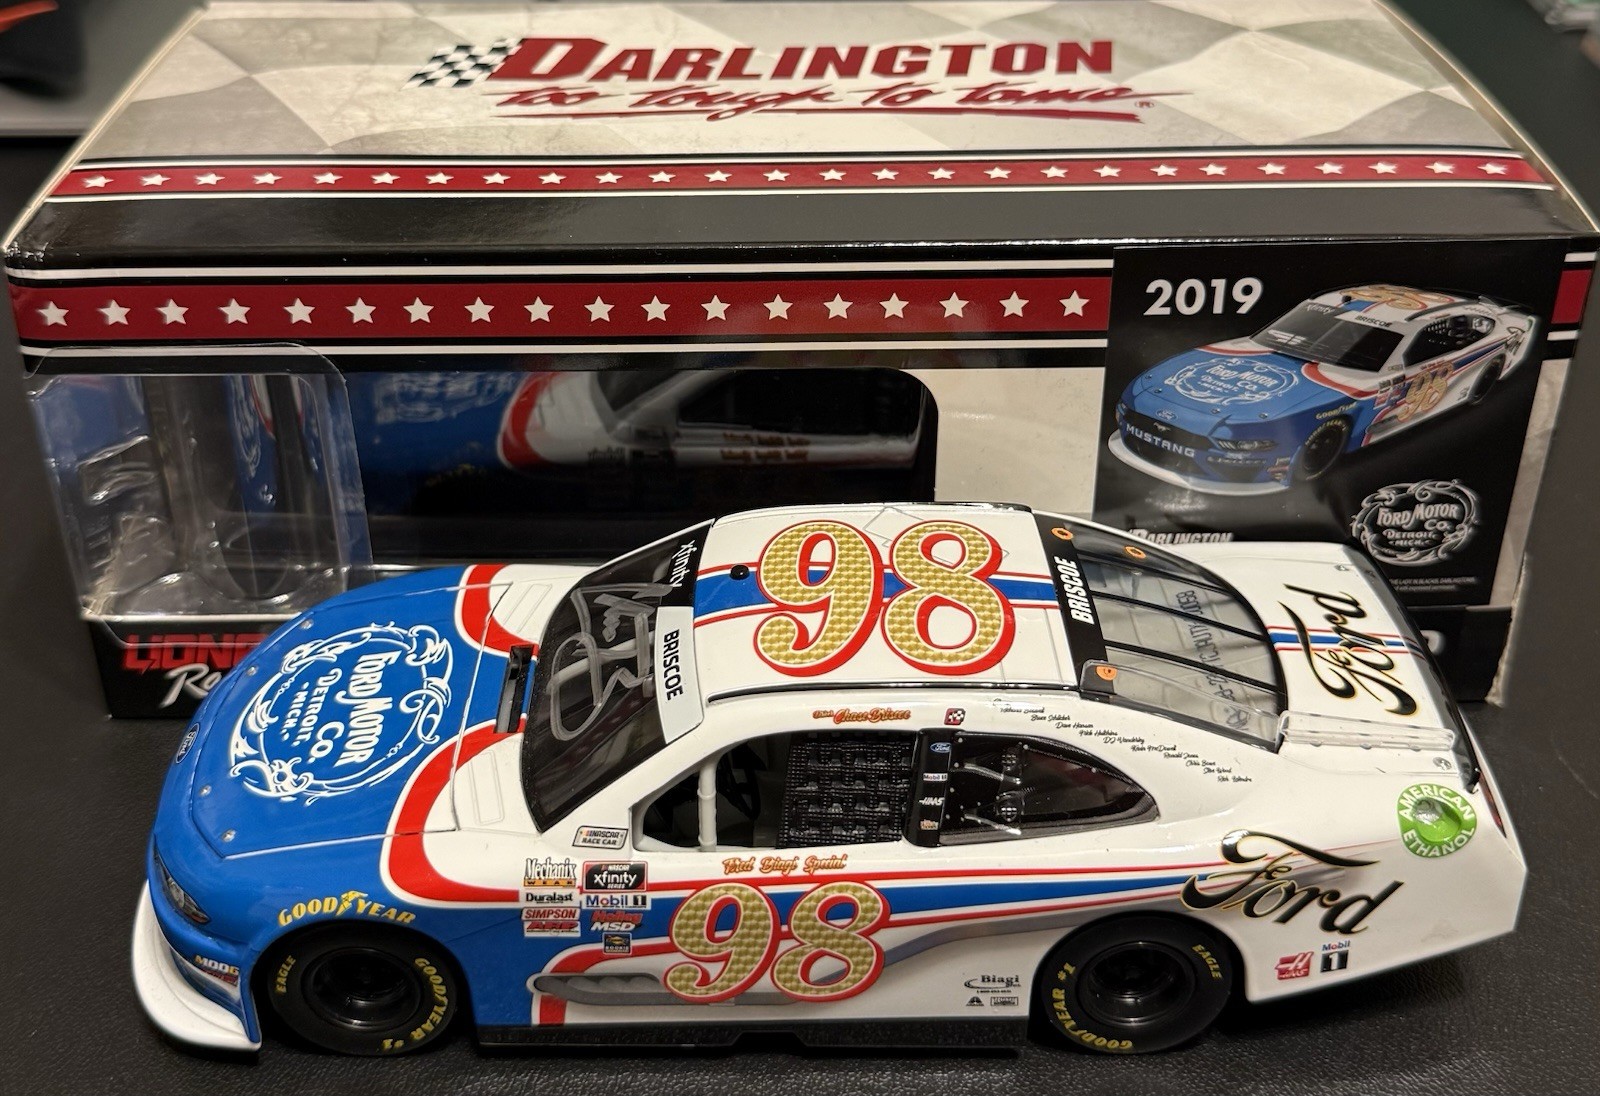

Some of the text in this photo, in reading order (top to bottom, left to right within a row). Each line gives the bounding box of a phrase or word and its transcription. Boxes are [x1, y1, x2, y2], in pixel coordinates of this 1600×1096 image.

[485, 37, 1112, 82] DARLINGTON
[1143, 277, 1264, 316] 2019
[1354, 315, 1393, 328] BRISCOE
[1125, 423, 1196, 458] MUSTANG
[1376, 503, 1460, 530] FORD MOTOR
[669, 539, 698, 588] xfinity
[752, 519, 1016, 678] 98
[1053, 555, 1095, 625] BRISCOE
[662, 628, 684, 701] BRISCOE
[1276, 583, 1418, 716] Ford
[333, 649, 402, 768] FORD MOTOR
[1398, 784, 1476, 823] AMERICAN
[581, 837, 618, 846] RACE CAR
[588, 829, 620, 839] NASCAR
[1402, 827, 1475, 858] ETHANOL
[524, 857, 577, 879] Mechanix
[593, 870, 637, 887] xfinity
[1181, 828, 1405, 935] Ford
[277, 890, 417, 927] GOODYEAR
[524, 908, 578, 919] SIMPSON
[525, 892, 573, 902] Duralast
[585, 894, 628, 906] Mobil
[590, 921, 637, 932] MSD
[663, 881, 892, 1004] 98
[1191, 943, 1224, 980] EAGLE
[1321, 940, 1351, 952] Mobil
[194, 954, 240, 976] MOOG
[275, 954, 297, 994] EAGLE
[981, 974, 1020, 988] Biagi
[410, 957, 449, 1041] GOODYEAR
[1052, 988, 1133, 1050] GOODYEAR
